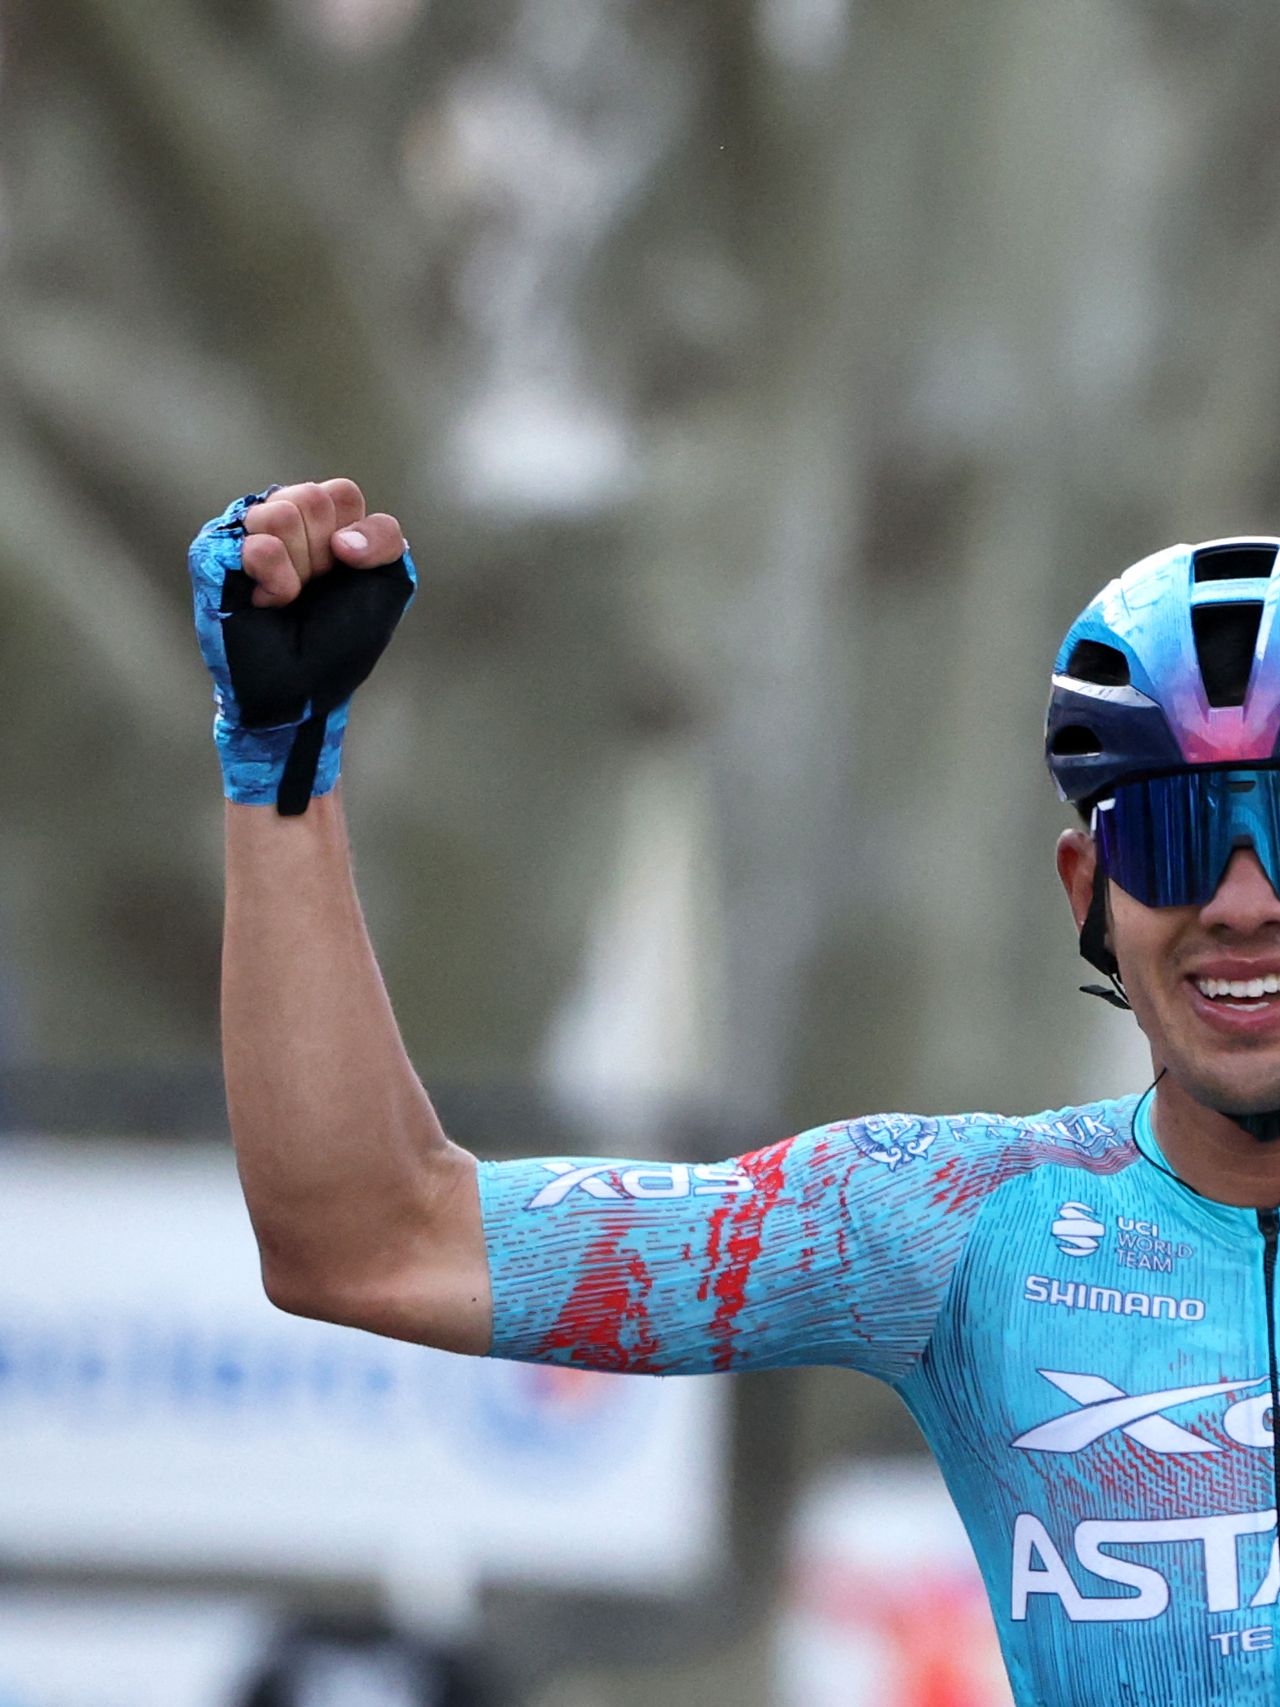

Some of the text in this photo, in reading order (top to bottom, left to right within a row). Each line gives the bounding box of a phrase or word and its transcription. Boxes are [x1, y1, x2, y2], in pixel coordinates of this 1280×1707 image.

[1117, 1216, 1159, 1238] UCI
[1117, 1232, 1194, 1260] WORLD
[1115, 1248, 1174, 1274] TEAM
[1024, 1275, 1206, 1321] SHIMANO
